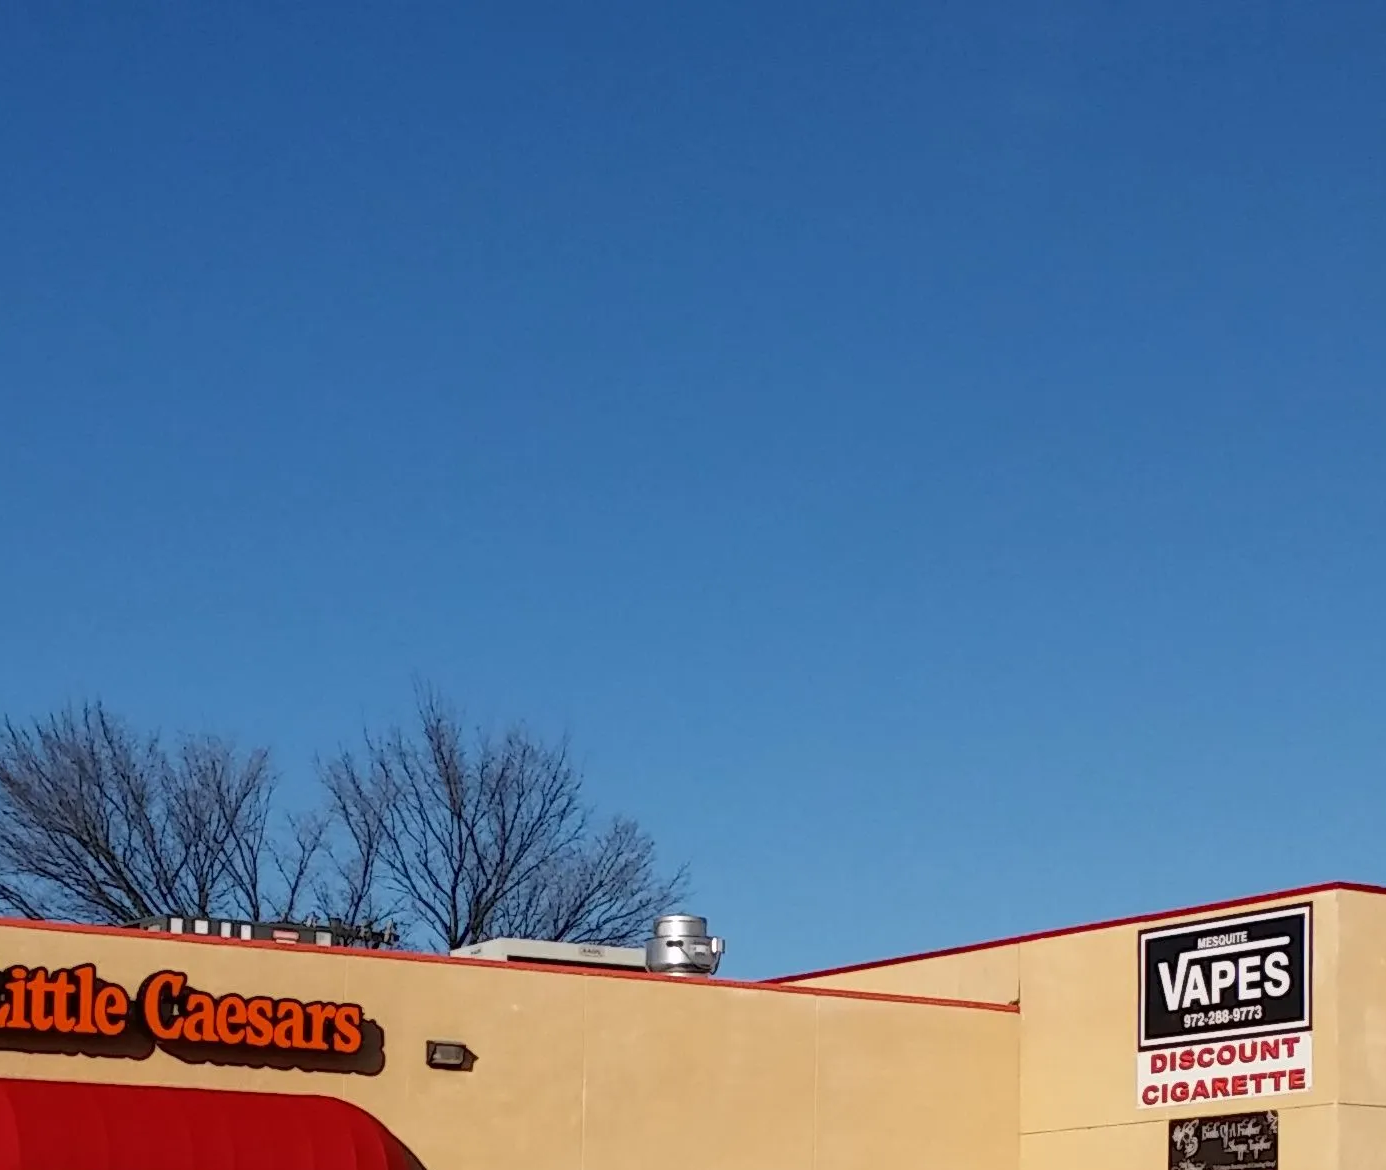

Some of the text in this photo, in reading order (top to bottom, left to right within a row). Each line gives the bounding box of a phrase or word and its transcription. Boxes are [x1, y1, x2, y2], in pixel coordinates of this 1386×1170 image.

[1197, 931, 1248, 949] MESQUITE
[1158, 938, 1291, 1011] VAPES
[144, 972, 363, 1053] Caesars
[1151, 1036, 1300, 1074] DISCOUNT
[1142, 1068, 1306, 1105] CIGARETTE
